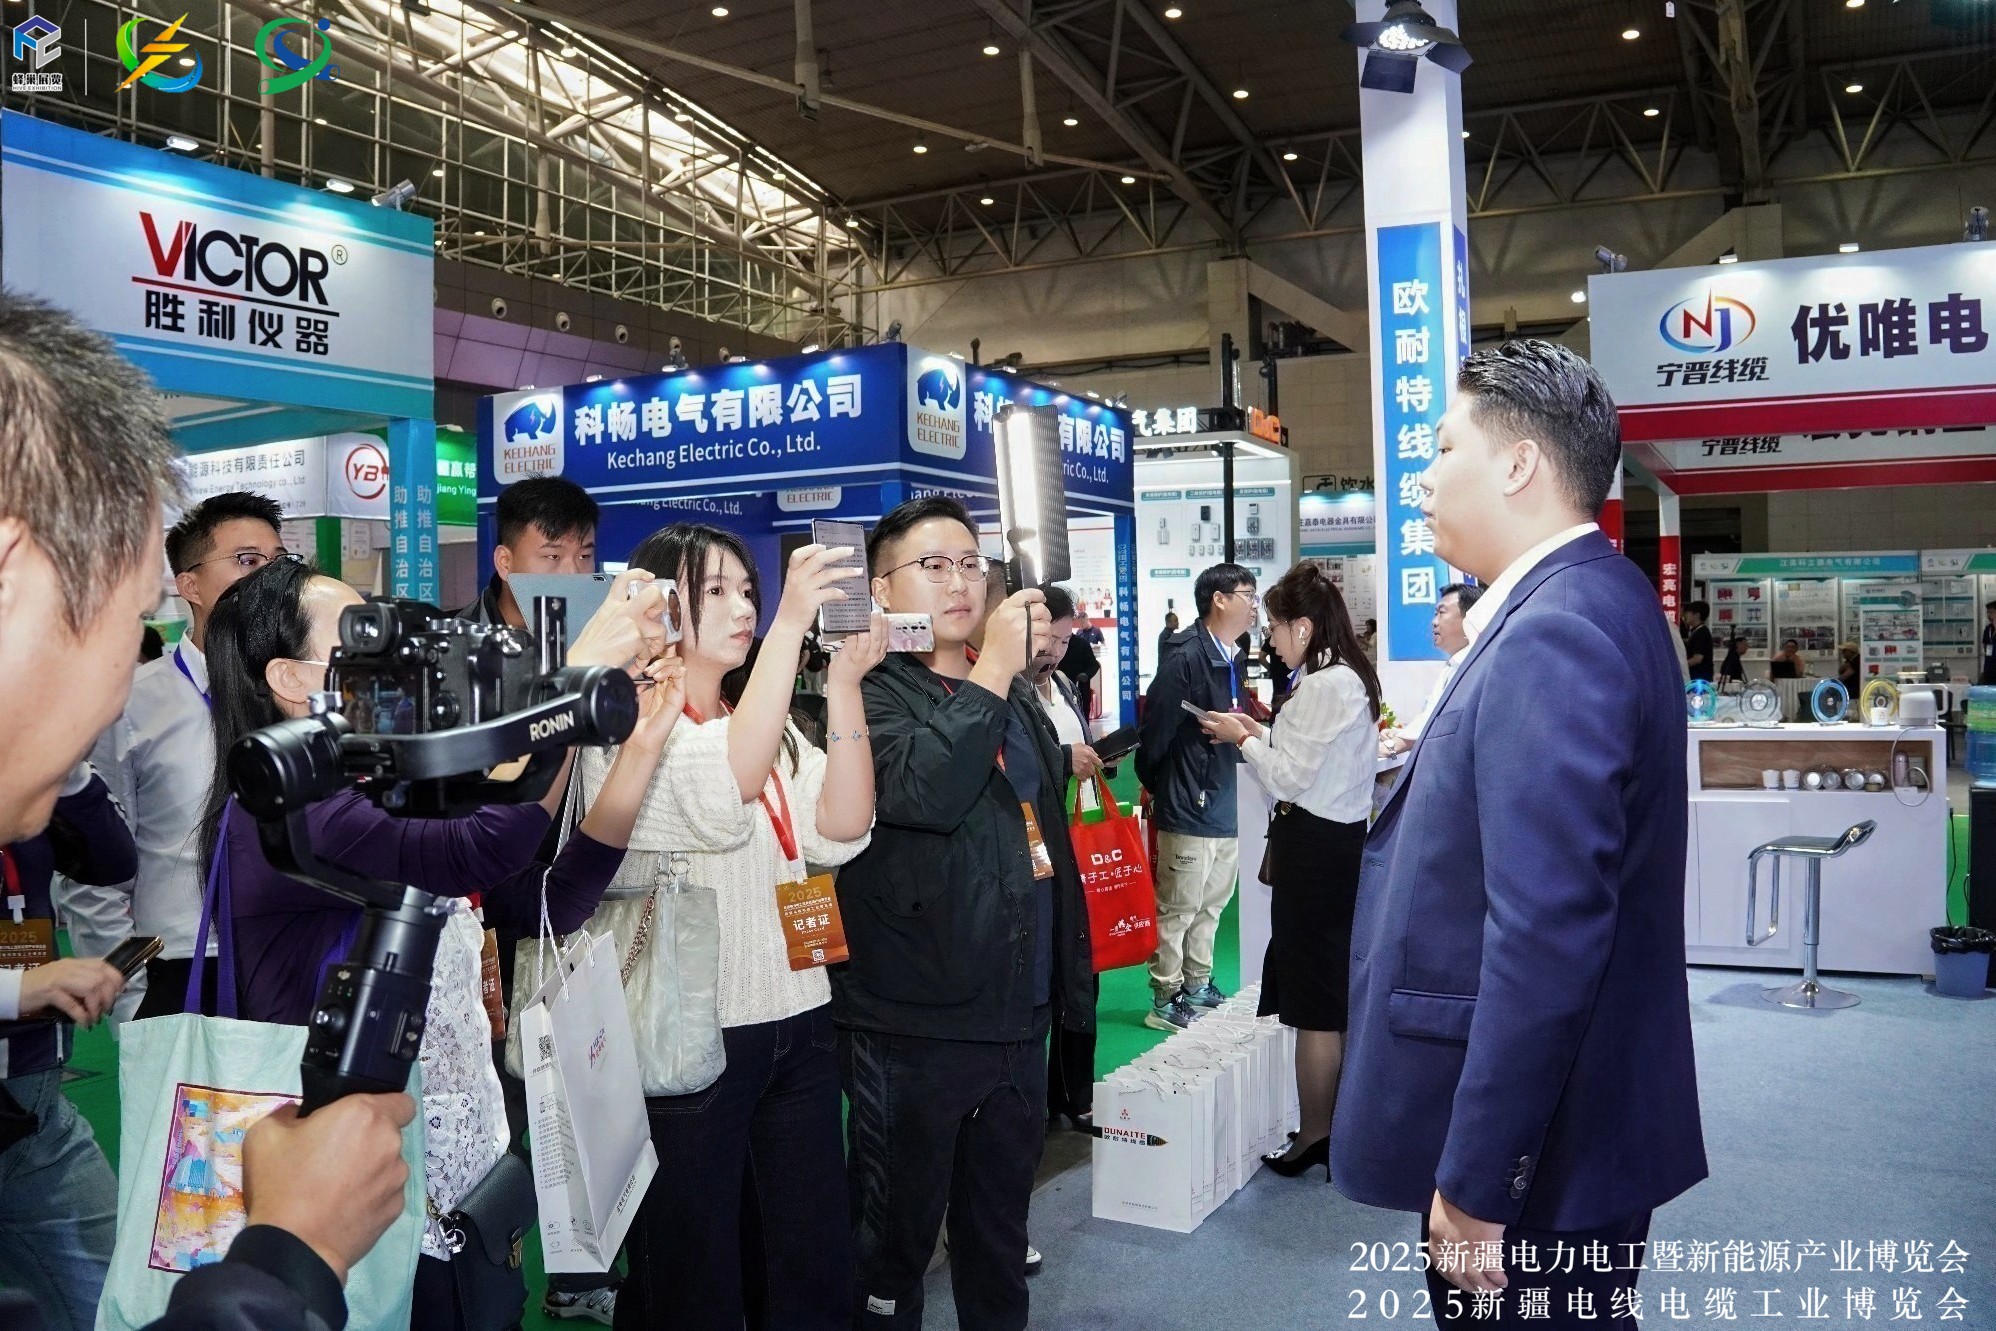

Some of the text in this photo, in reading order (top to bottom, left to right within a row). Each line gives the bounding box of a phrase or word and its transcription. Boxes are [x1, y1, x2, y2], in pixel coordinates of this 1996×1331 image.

[139, 211, 329, 305] VICTOR
[145, 289, 329, 356] 胜利仪器
[1791, 293, 1989, 364] 优唯电
[1656, 356, 1769, 387] 宁晋线缆
[574, 374, 862, 446] 科畅电气有限公司
[916, 412, 960, 433] KECHANG
[1132, 406, 1197, 437] 气集团
[607, 431, 821, 470] Kechang Electric Co., Ltd.
[917, 427, 960, 449] ELECTRIC
[1393, 279, 1435, 605] 欧耐特线缆集团
[1701, 436, 1782, 456] 宁晋线缆
[504, 444, 556, 460] KECHANG
[504, 458, 555, 474] ELECTRIC
[1093, 465, 1109, 483] Ltd.
[236, 480, 277, 491] Technology
[787, 491, 833, 504] ELECTRIC
[724, 501, 743, 516] Ltd.
[394, 485, 410, 598] 助推自治区
[417, 484, 434, 601] 助推自治区
[1118, 586, 1131, 700] 科畅电气有限公司
[529, 710, 575, 743] RONIN
[1091, 849, 1123, 865] D&C
[788, 886, 822, 903] 2025
[793, 913, 831, 931] 记者证
